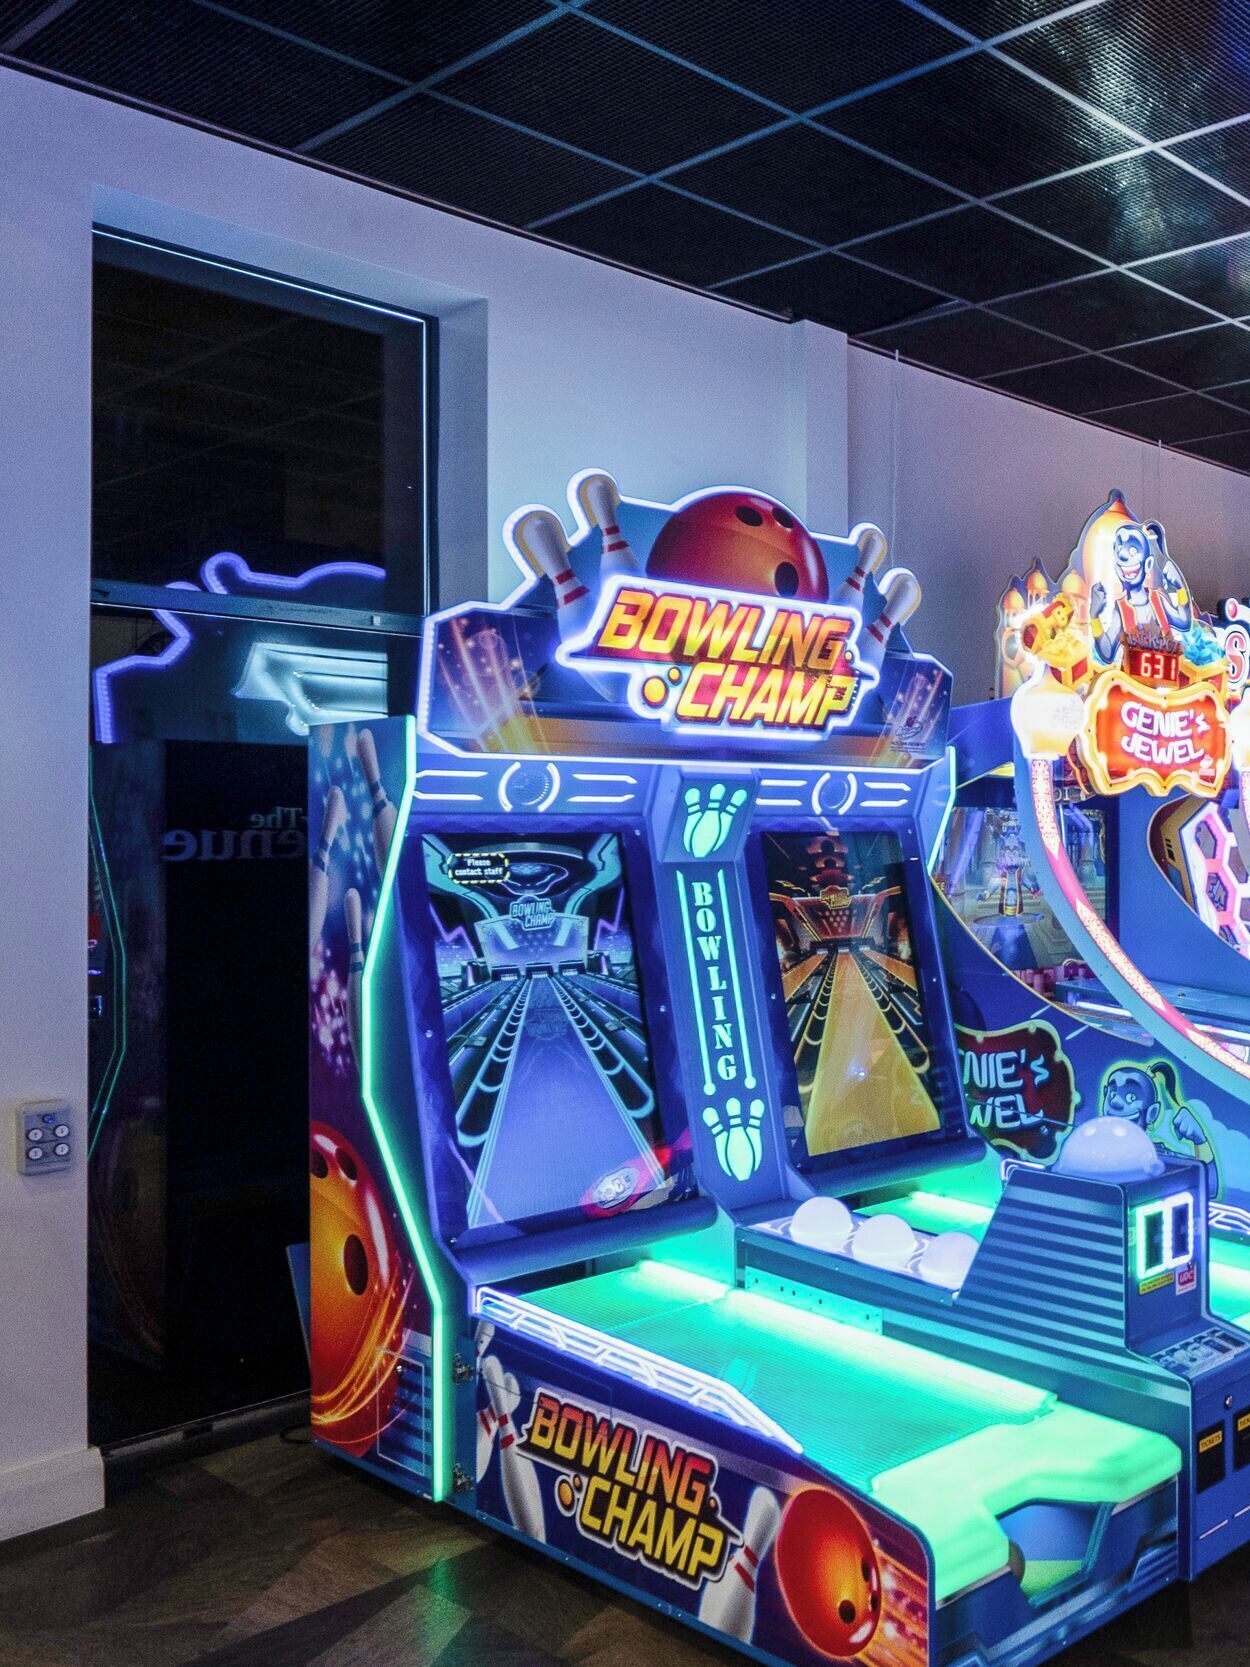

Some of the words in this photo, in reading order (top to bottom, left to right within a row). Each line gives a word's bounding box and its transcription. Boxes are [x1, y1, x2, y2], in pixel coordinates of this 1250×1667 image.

[597, 588, 854, 672] BOWLING
[1141, 652, 1176, 680] 631
[675, 661, 857, 725] CHAMP
[1120, 732, 1205, 765] JEWEL
[455, 867, 482, 876] contact
[484, 866, 504, 876] staff
[511, 901, 551, 918] BOWLING
[524, 913, 555, 928] CHAMP
[690, 881, 737, 1081] BOWLING
[529, 1391, 712, 1516] BOWLING
[1200, 1434, 1221, 1449] TICKETS
[579, 1474, 725, 1577] CHAMP
